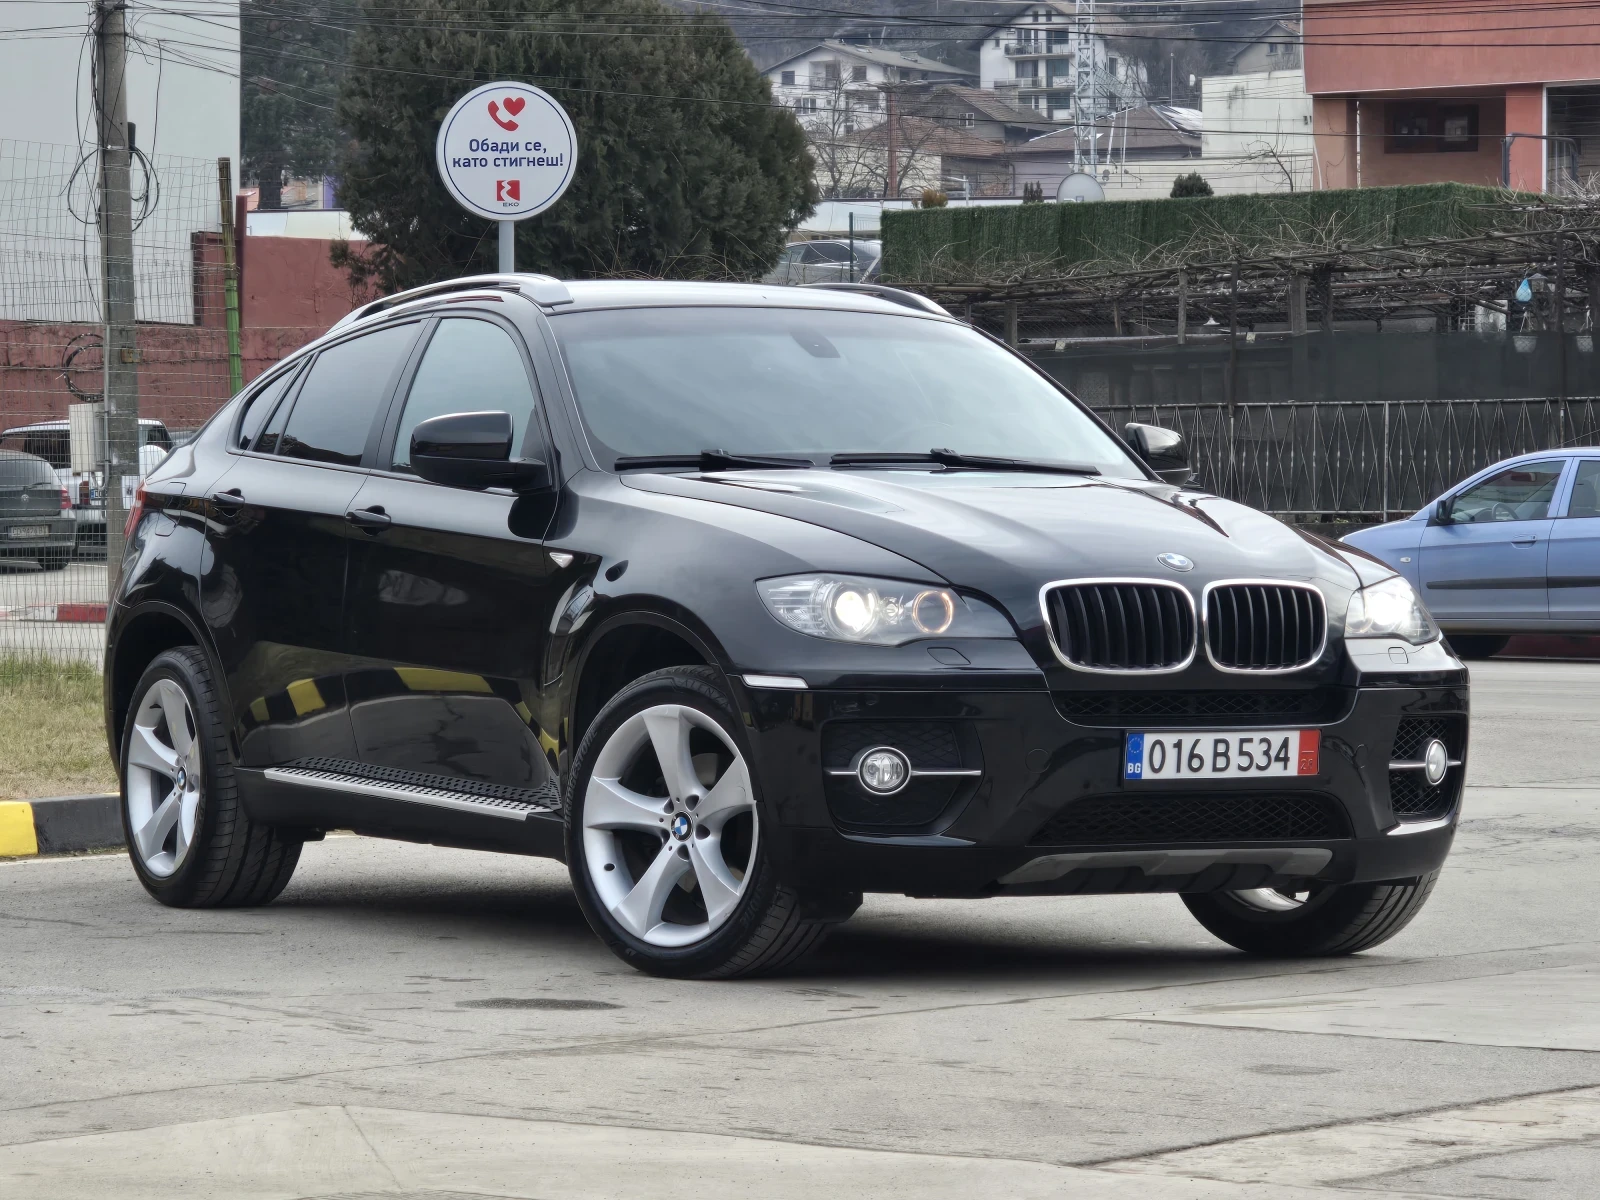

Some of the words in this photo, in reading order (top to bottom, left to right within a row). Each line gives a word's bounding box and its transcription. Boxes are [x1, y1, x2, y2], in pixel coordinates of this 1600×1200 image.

[469, 138, 519, 154] Обади
[525, 141, 547, 153] се,
[452, 157, 488, 168] като
[493, 153, 564, 167] стигнеш!
[1127, 762, 1142, 773] BG
